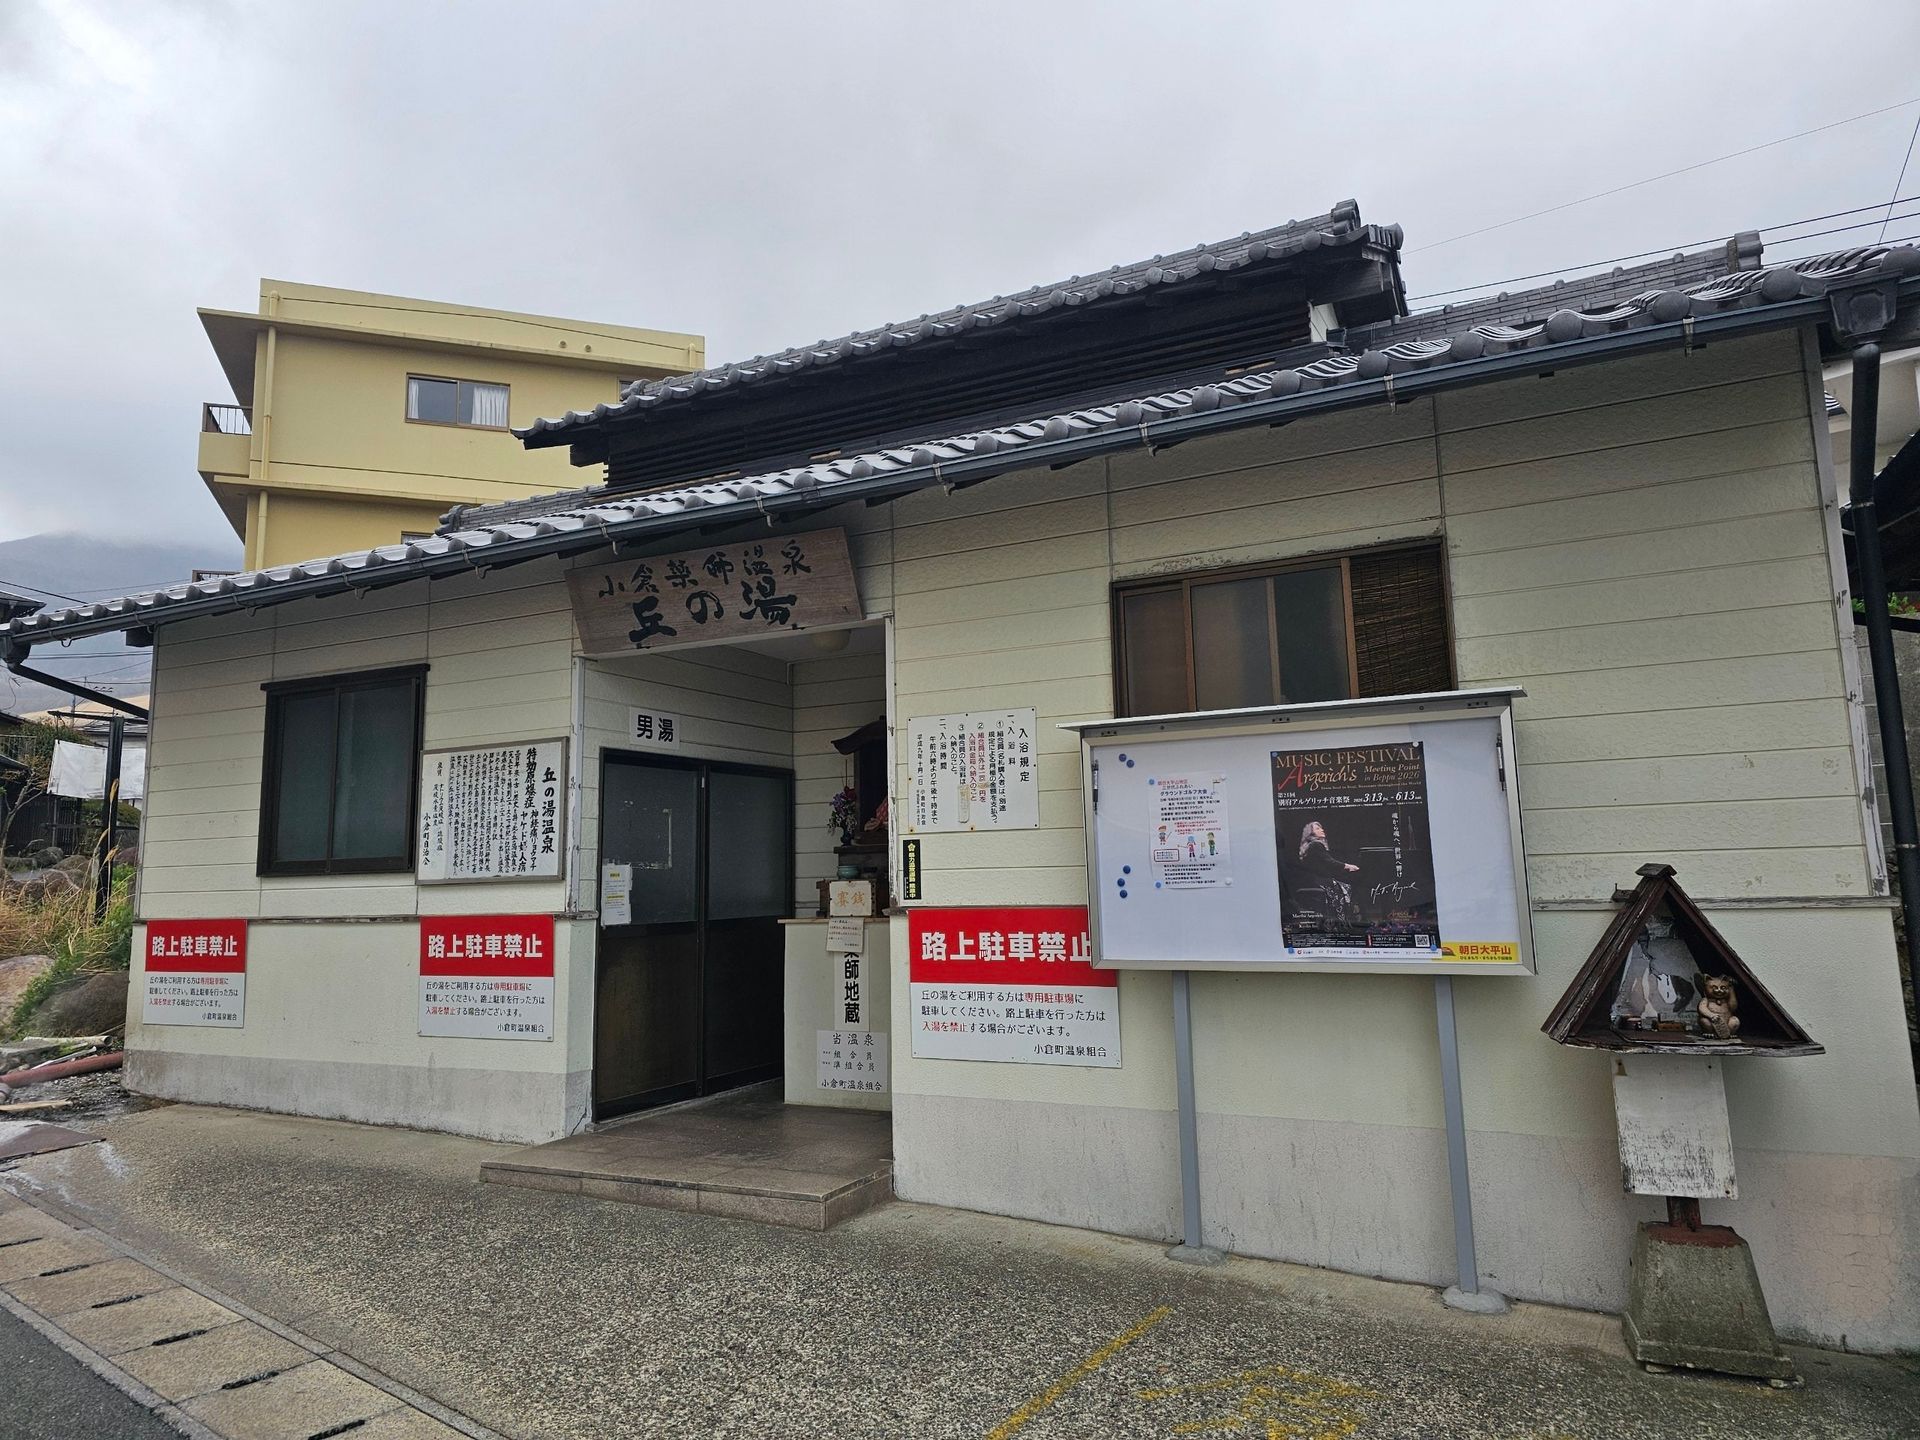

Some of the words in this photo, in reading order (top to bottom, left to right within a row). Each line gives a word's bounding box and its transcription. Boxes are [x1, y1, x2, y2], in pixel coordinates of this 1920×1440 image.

[599, 539, 811, 598] 小倉薬師温泉
[628, 576, 798, 642] 丘の湯
[637, 714, 674, 743] 男湯
[1019, 728, 1030, 783] 入浴規定
[1276, 752, 1332, 768] MUSIC
[1337, 748, 1420, 764] FESTIVAL
[1278, 760, 1358, 791] Argerich's
[1364, 764, 1396, 773] Meeting
[1373, 774, 1396, 782] Beppu
[1278, 796, 1350, 806] 別府アルゲリッチ音楽祭
[541, 766, 557, 854] 丘の湯温泉
[152, 934, 238, 958] 路上駐車禁止
[428, 934, 543, 959] 路上駐車禁止
[921, 931, 1091, 962] 路上駐車禁止
[1460, 944, 1511, 955] 朝日大平山
[426, 980, 532, 992] 丘の湯をご利用する方は専用駐車場に
[426, 993, 546, 1006] 駐車してください。路上駐車を行った方は
[922, 990, 1084, 1004] 丘の湯をご利用する方は専用駐車場に
[201, 1012, 238, 1022] 小倉町温泉組合
[426, 1006, 523, 1018] 入湯を禁止する場合がございます。
[922, 1006, 1106, 1022] 駐車してください。路上駐車を行った方は
[496, 1022, 545, 1034] 小倉町温泉組合
[922, 1022, 1071, 1037] 入湯を禁止する場合がございます。
[832, 1033, 874, 1046] 当温泉
[1034, 1044, 1108, 1058] 小倉町温泉組合
[822, 1078, 882, 1091] 小倉町温泉組合
